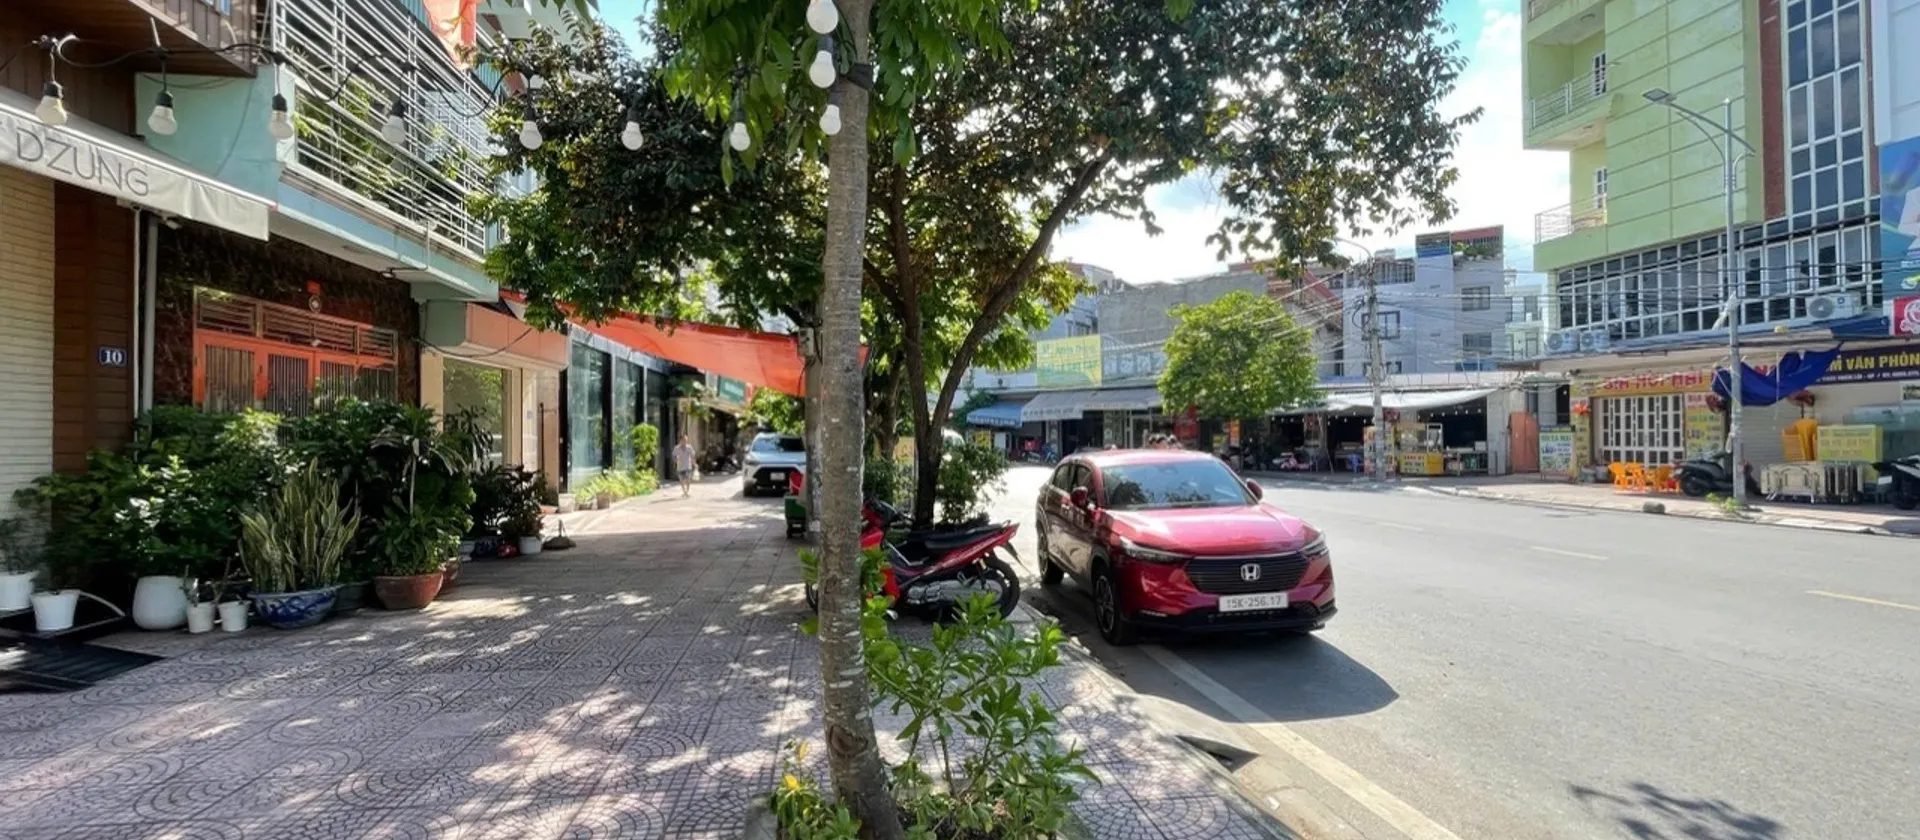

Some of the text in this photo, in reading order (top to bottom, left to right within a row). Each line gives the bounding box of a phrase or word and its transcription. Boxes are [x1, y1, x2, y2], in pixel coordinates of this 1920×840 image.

[16, 126, 149, 196] DZUNG
[105, 350, 122, 365] 10
[1846, 354, 1875, 370] VĂN
[1226, 595, 1281, 609] 15K-256.17
